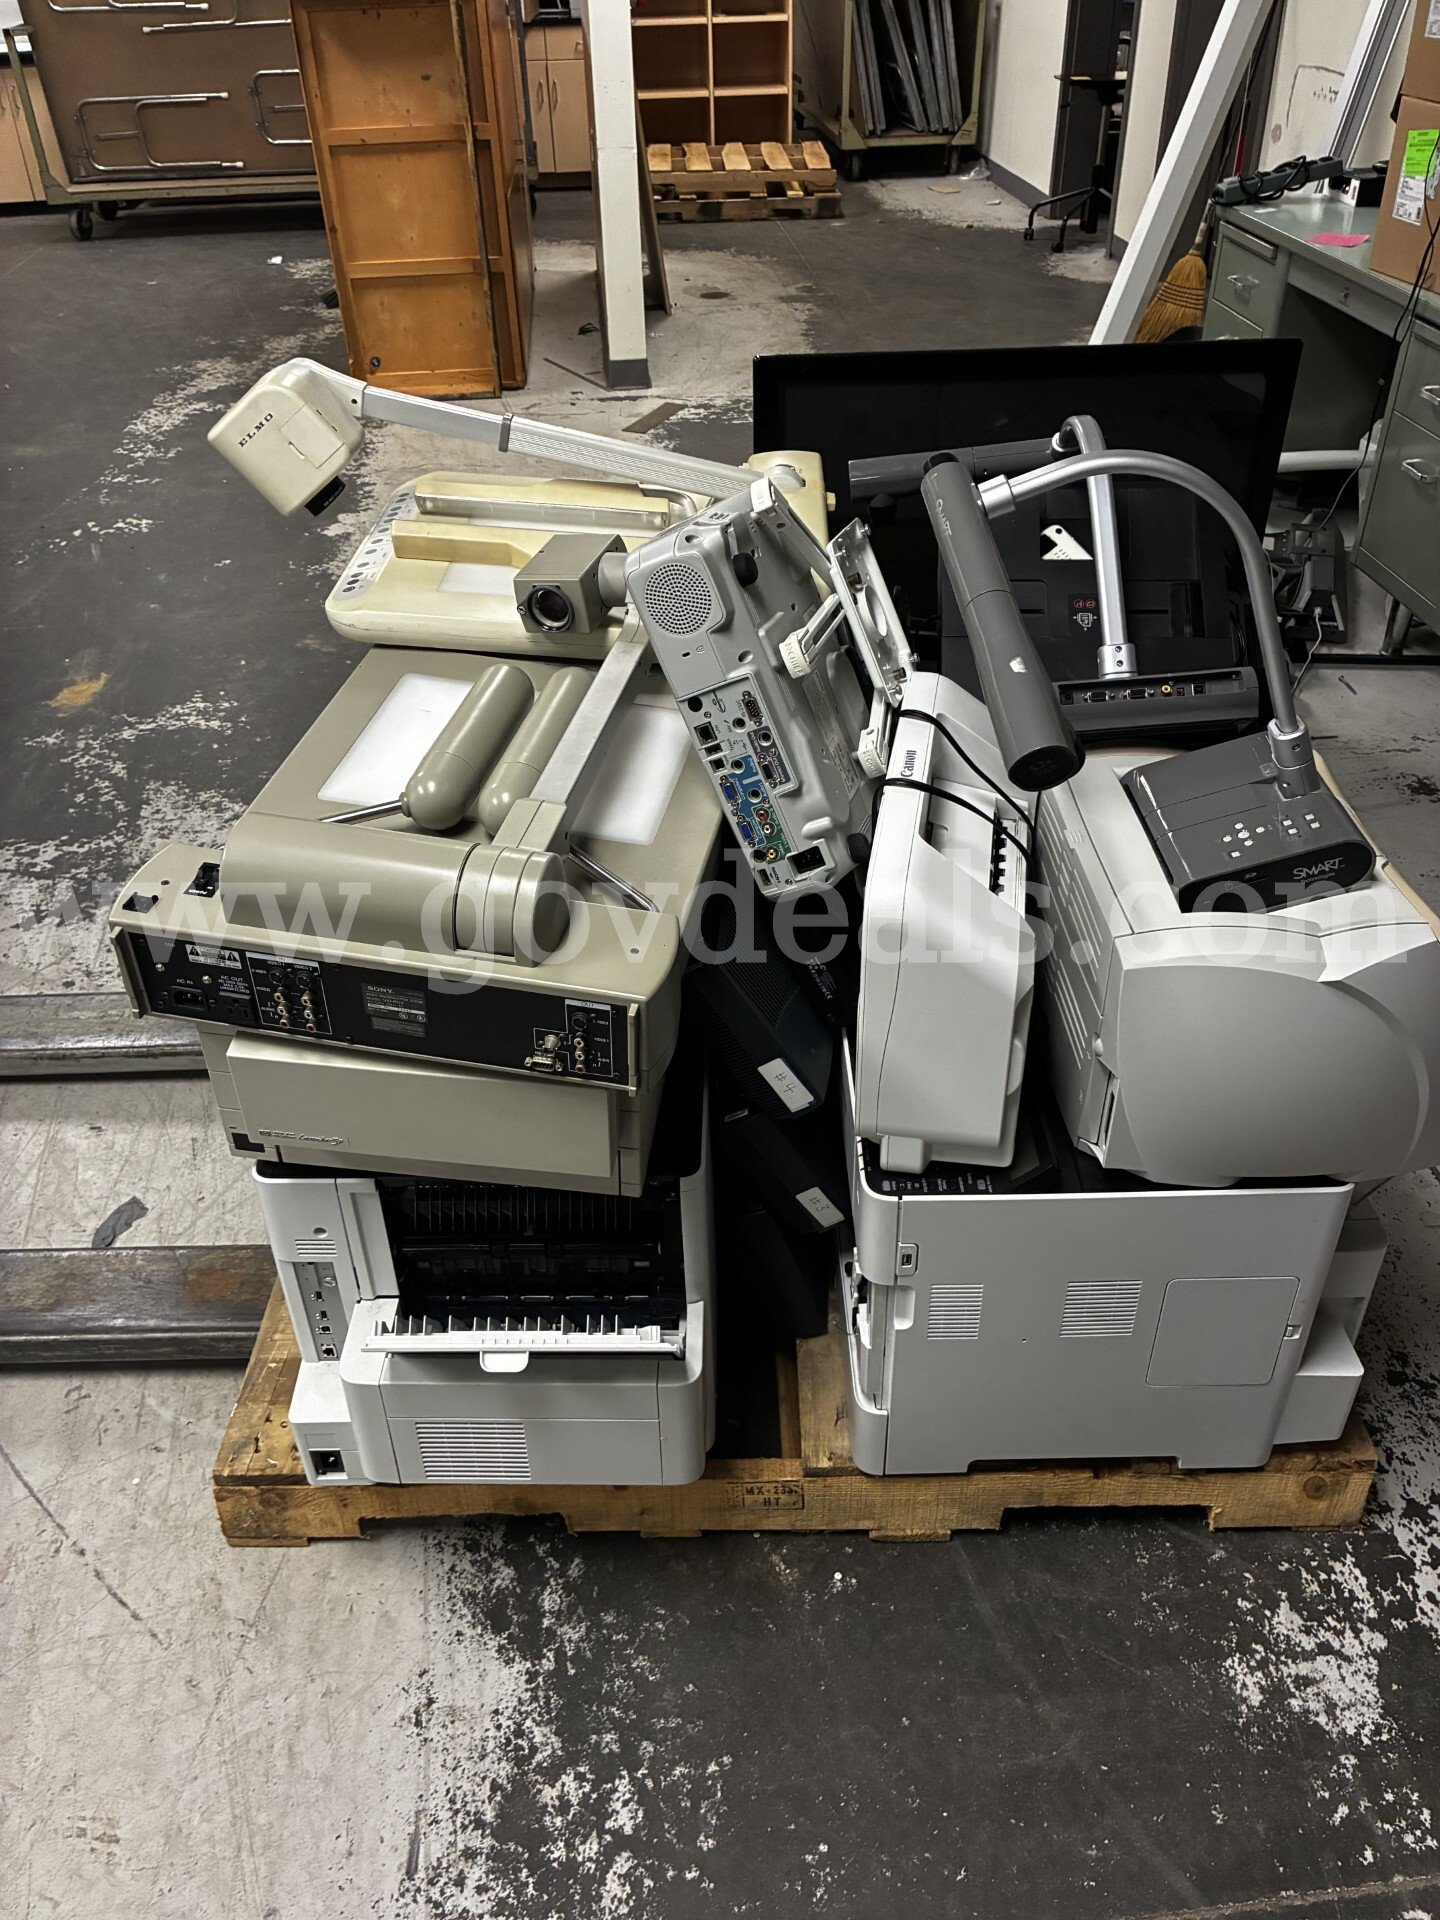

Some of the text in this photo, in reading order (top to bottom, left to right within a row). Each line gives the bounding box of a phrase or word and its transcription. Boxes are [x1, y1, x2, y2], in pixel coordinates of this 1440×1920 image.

[238, 412, 273, 448] ELMO
[901, 750, 917, 778] Canon
[1293, 858, 1343, 880] SMART
[367, 985, 393, 994] SONY
[763, 1497, 781, 1507] HT
